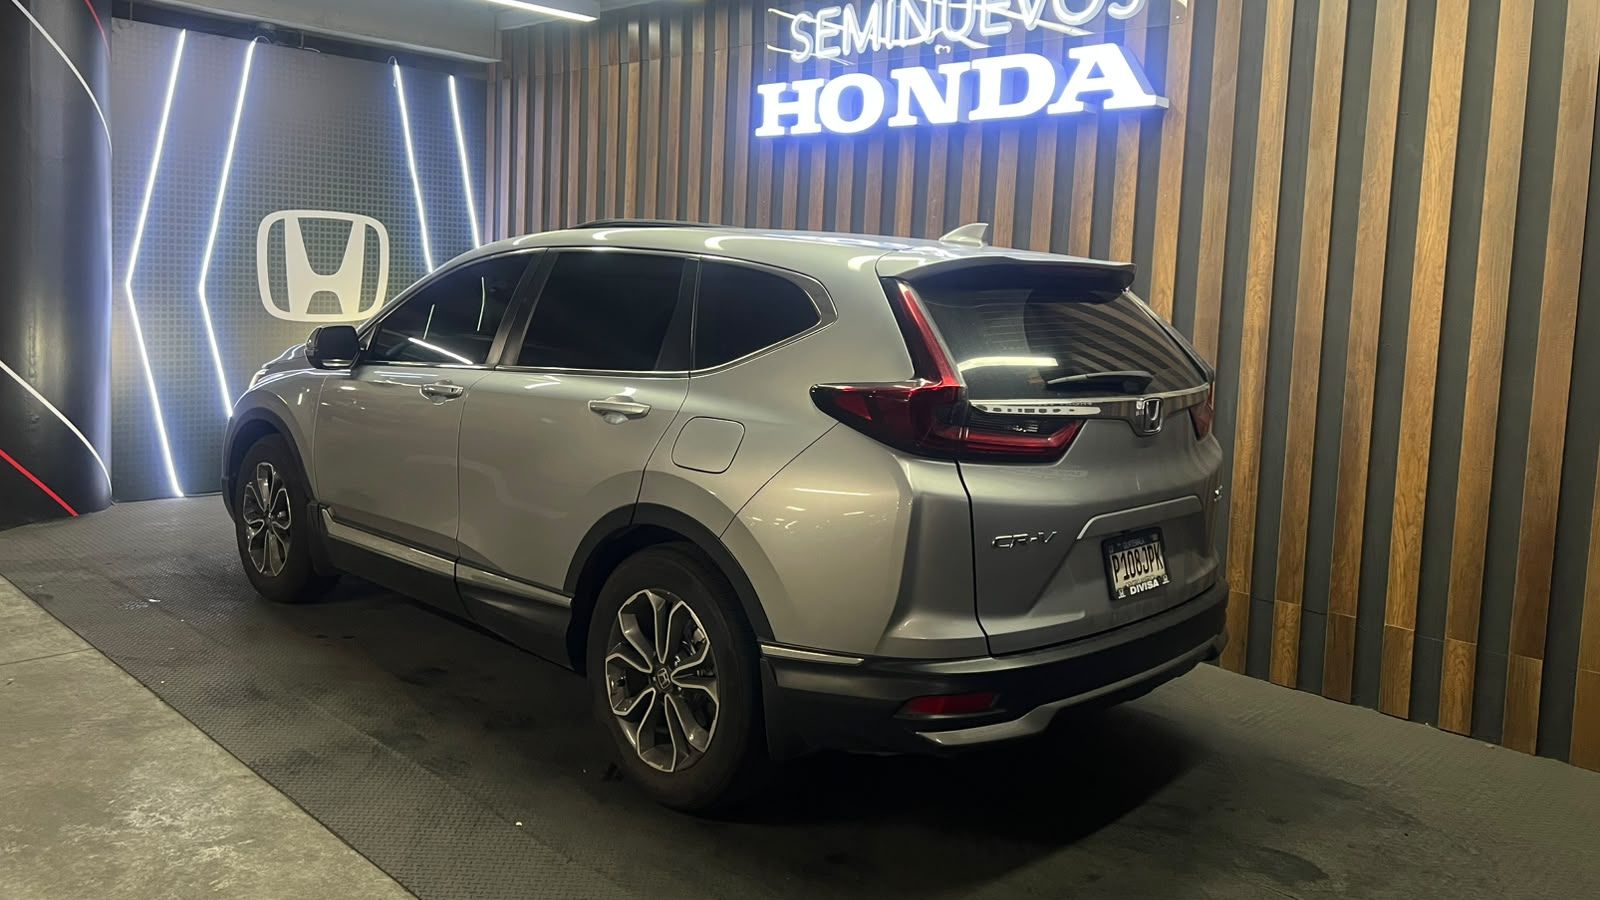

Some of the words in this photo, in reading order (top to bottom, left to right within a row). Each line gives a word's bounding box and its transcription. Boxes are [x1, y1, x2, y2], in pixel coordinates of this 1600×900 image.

[755, 43, 1160, 137] HONDA
[991, 531, 1057, 549] CR-V
[1112, 541, 1163, 583] P108JPK
[1129, 579, 1160, 595] DIVISA
